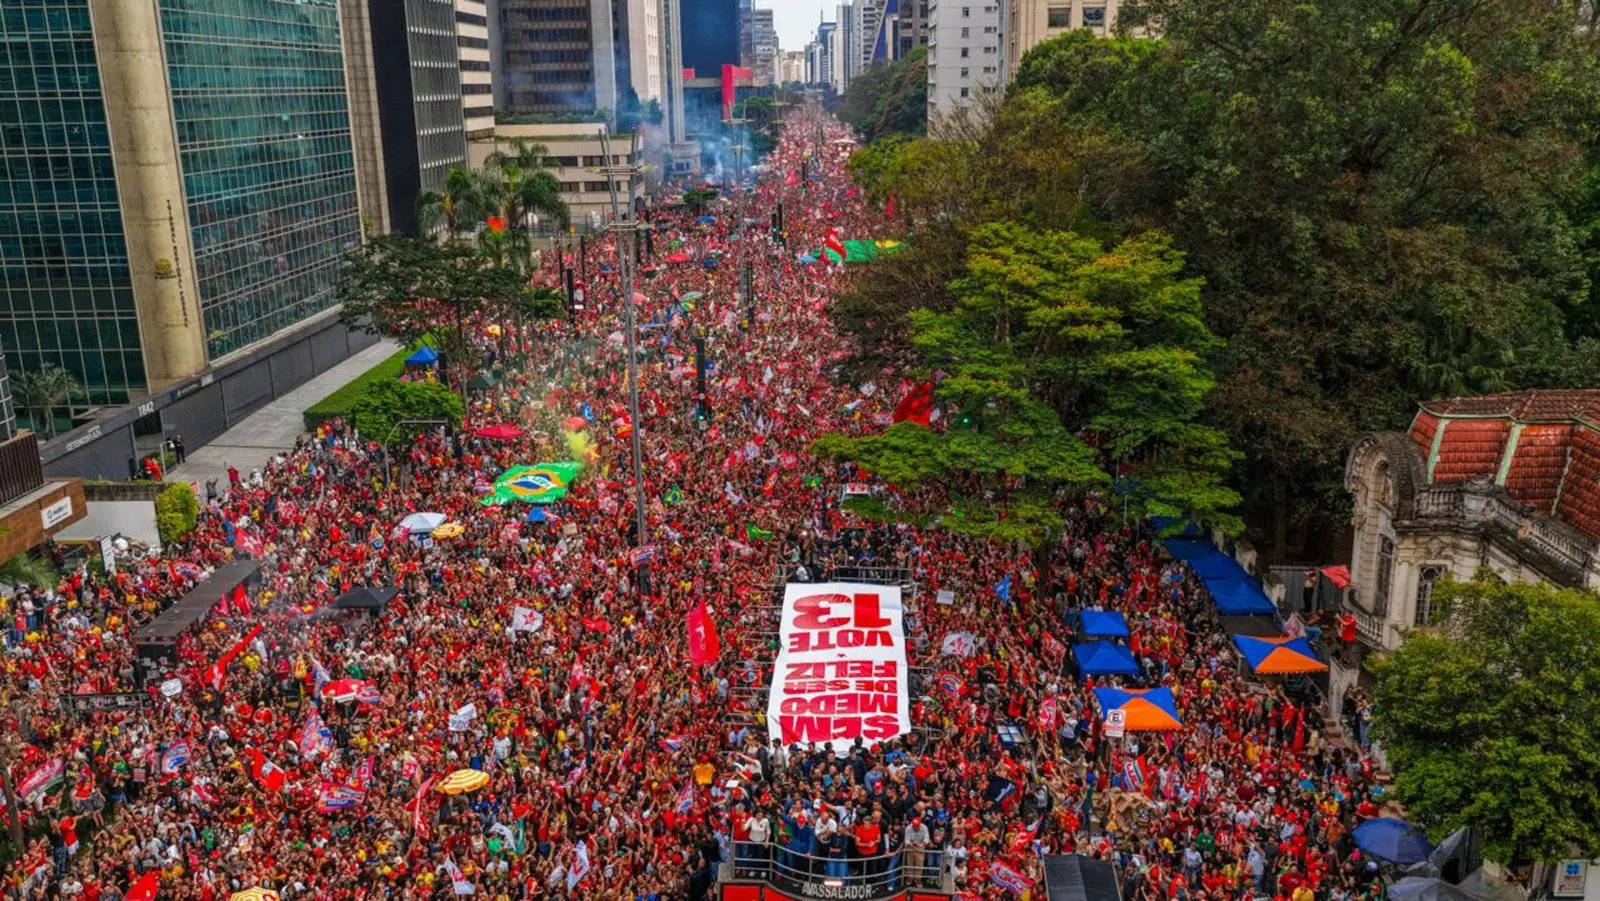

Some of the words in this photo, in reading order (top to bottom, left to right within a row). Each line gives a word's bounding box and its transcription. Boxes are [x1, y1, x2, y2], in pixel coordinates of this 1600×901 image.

[138, 401, 154, 417] 1842
[792, 593, 892, 630] 13
[788, 630, 894, 652] VOTE
[784, 660, 897, 681] FELIZ
[783, 680, 850, 695] SER
[855, 679, 898, 694] DE
[780, 693, 898, 715] MEDO
[779, 714, 900, 746] SEM
[801, 882, 873, 899] AVASSALADOR
